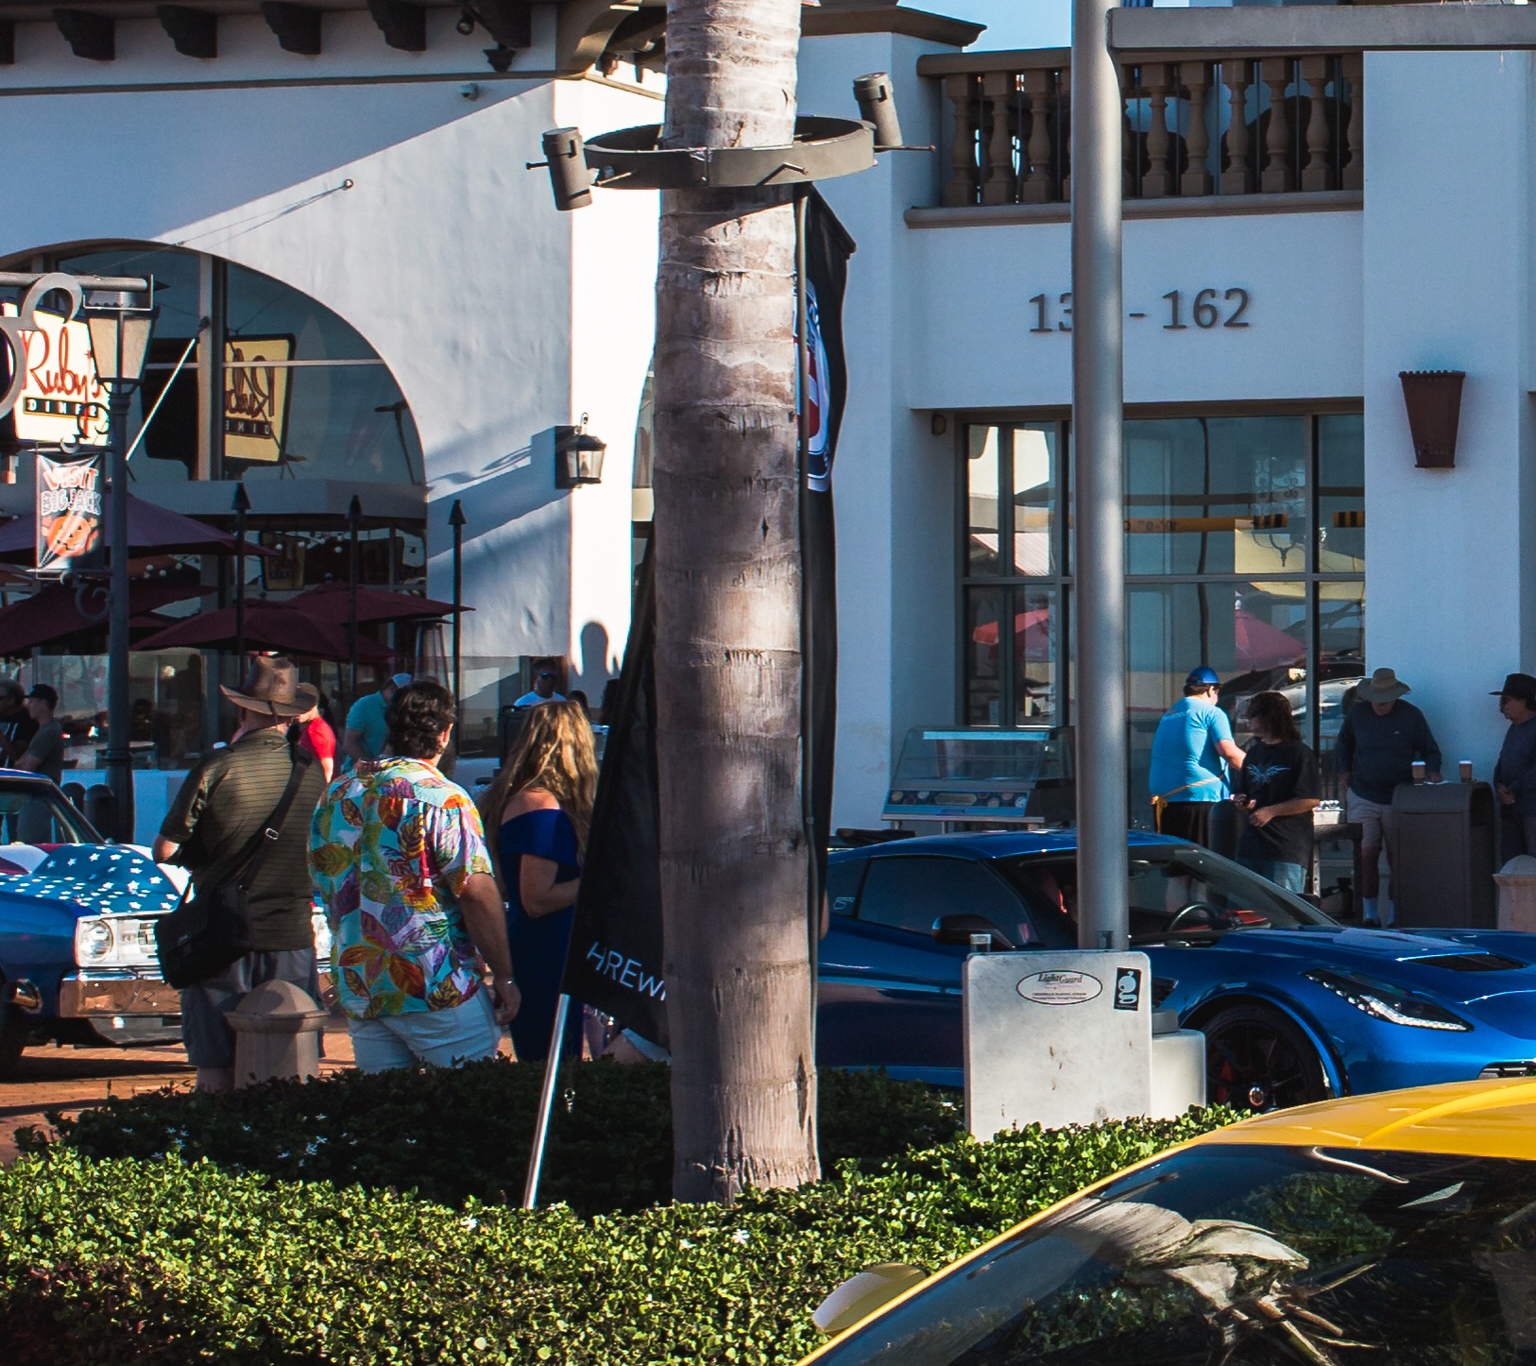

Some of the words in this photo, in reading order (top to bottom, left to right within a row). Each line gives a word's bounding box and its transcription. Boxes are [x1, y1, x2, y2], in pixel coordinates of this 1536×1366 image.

[1028, 292, 1073, 333] 13
[1162, 287, 1250, 330] 162
[43, 466, 99, 491] VISIT
[41, 488, 69, 516] BIG
[68, 488, 101, 516] JACK
